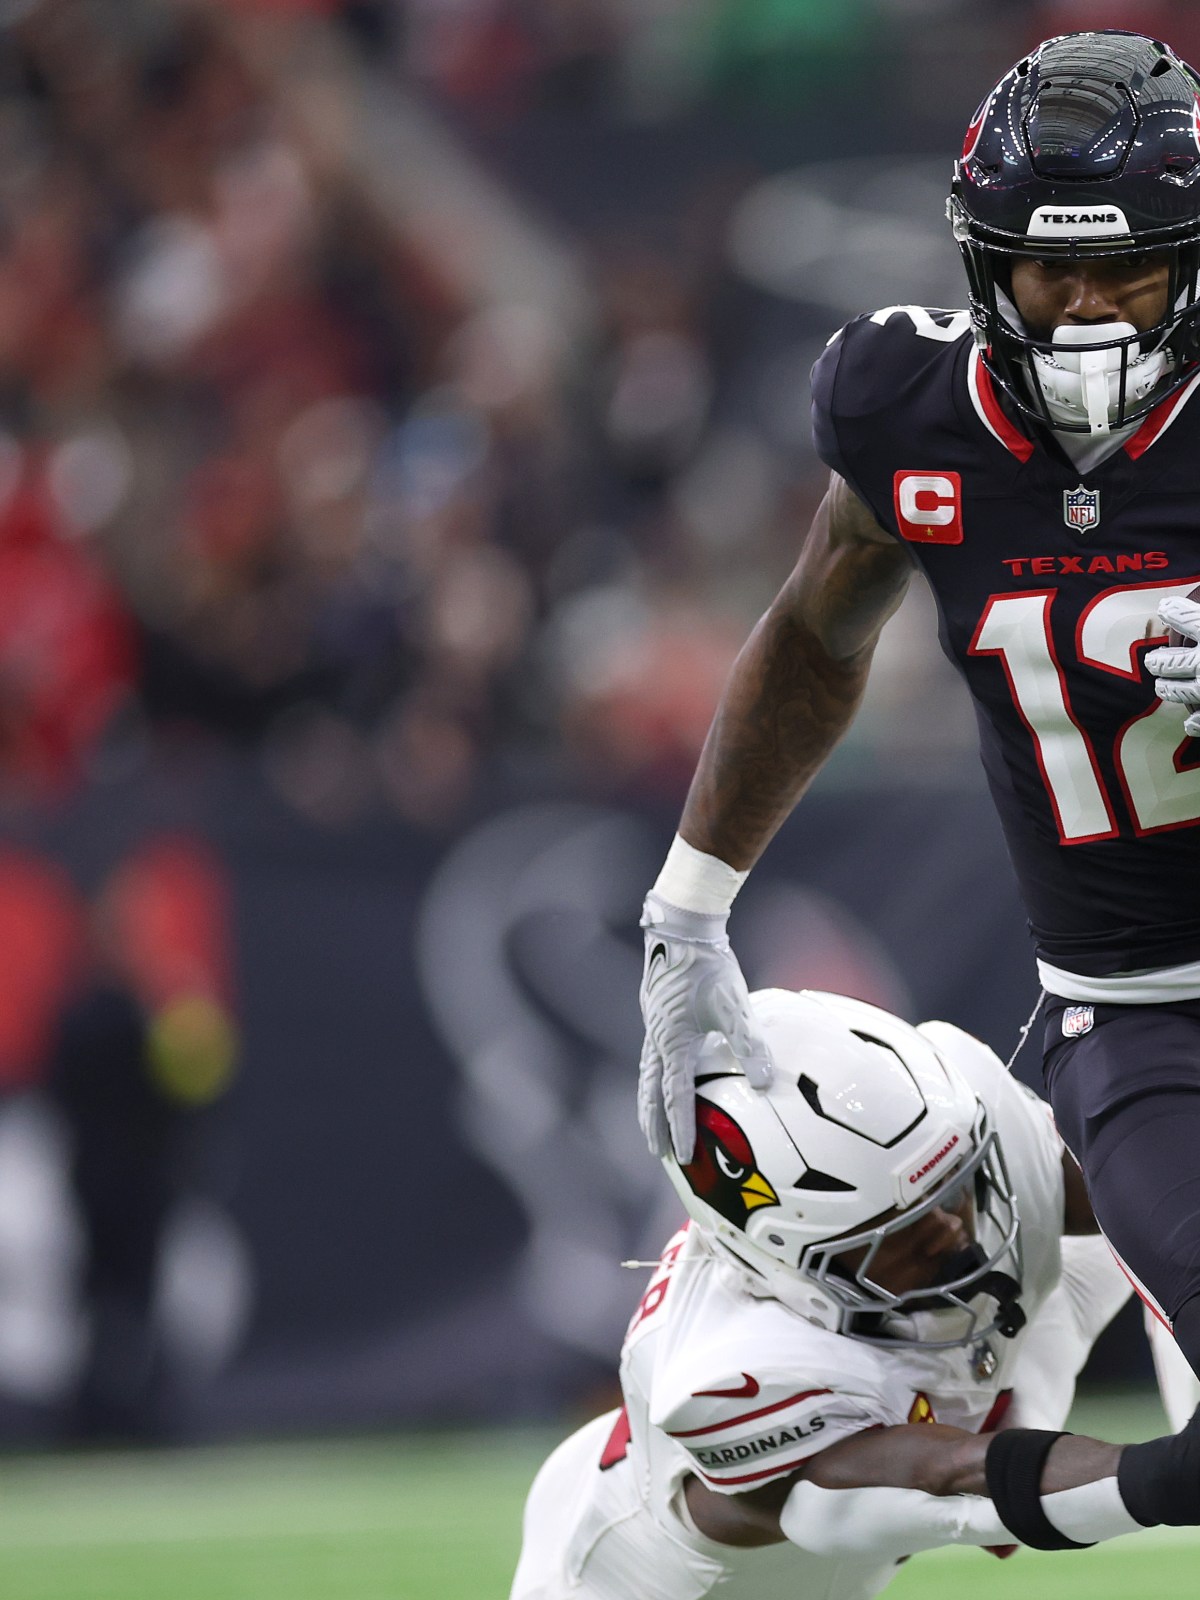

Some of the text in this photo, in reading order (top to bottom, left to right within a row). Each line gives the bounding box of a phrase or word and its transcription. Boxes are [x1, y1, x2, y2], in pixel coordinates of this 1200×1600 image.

[1039, 213, 1118, 224] TEXANS
[898, 475, 956, 526] C
[1069, 507, 1096, 525] NFL
[1001, 551, 1170, 577] TEXANS
[908, 1134, 960, 1185] CARDINALS
[697, 1415, 826, 1466] CARDINALS
